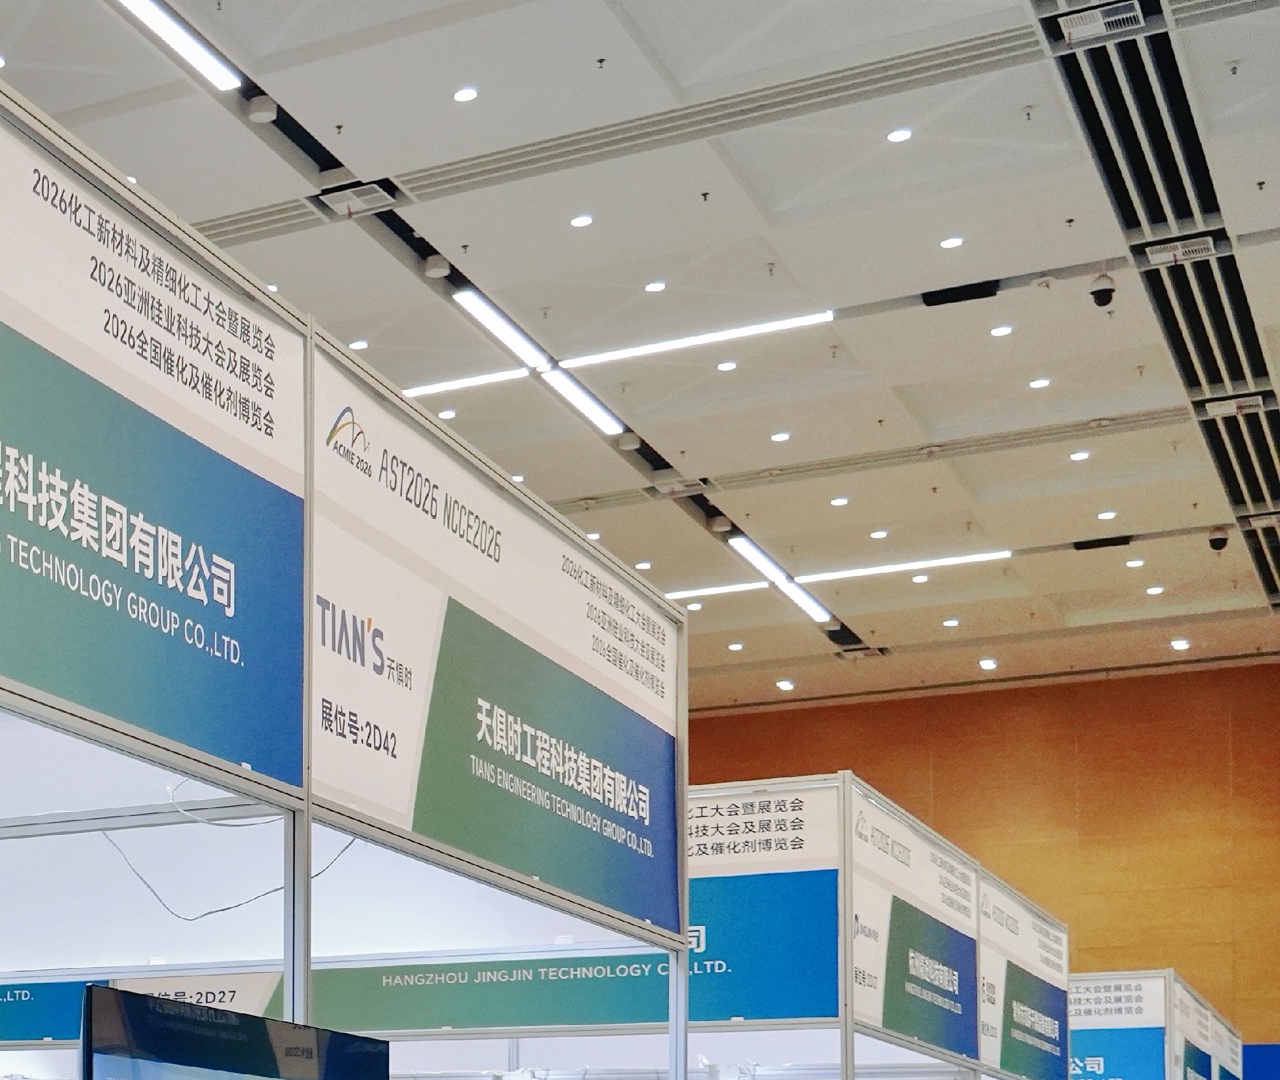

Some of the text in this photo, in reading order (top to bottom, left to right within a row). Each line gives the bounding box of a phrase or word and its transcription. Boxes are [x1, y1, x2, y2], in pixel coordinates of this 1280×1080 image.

[32, 168, 276, 362] 2026化工新材料及精细化工大会暨展览会
[89, 255, 275, 401] 2026亚洲硅业科技大会及展览会
[103, 308, 275, 439] 2026全国催化及催化剂博览会
[355, 455, 373, 478] 2026
[378, 448, 502, 564] AST2026 NCCE2026
[6, 533, 123, 610] TECHNOLOGY
[126, 592, 179, 638] GROUP
[183, 620, 245, 668] CO.,LTD.
[321, 697, 397, 760] 展位号:2D42
[386, 656, 413, 692] 天俱时
[470, 754, 496, 785] TIANS
[497, 767, 550, 810] ENGINEERING
[551, 793, 601, 833] TECHNOLOGY
[601, 818, 627, 844] GROUP
[476, 697, 650, 826] 天俱时工程科技集团有限公司
[382, 963, 651, 988] HANGZHOU JINGJIN TECHNOLOGY
